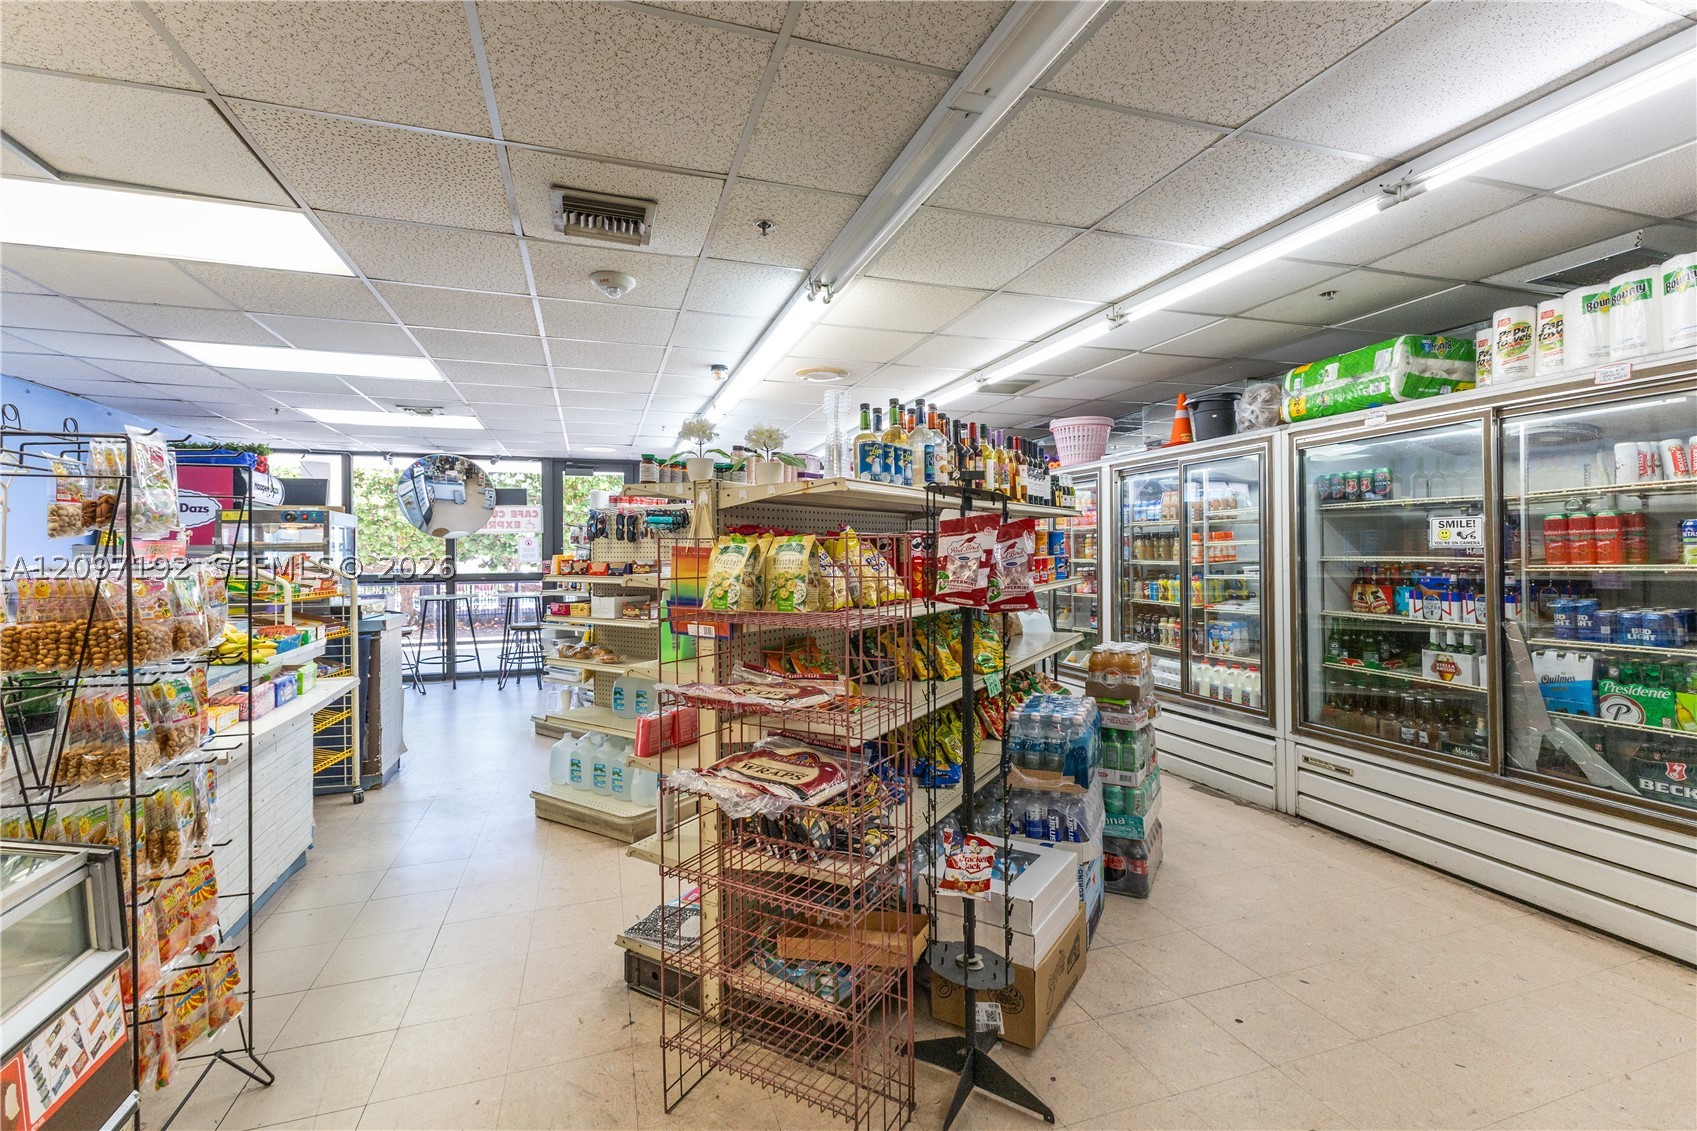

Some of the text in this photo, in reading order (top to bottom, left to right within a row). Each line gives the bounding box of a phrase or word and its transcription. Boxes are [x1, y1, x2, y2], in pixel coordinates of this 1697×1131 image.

[1610, 283, 1646, 307] Bounty
[180, 503, 210, 513] Dazs
[1438, 519, 1476, 529] SMILE!
[1627, 633, 1657, 641] LIGHT
[1541, 673, 1576, 685] Quilmes
[1601, 681, 1671, 700] Presidente
[1454, 747, 1477, 758] Modelo
[738, 762, 806, 780] WRAPS
